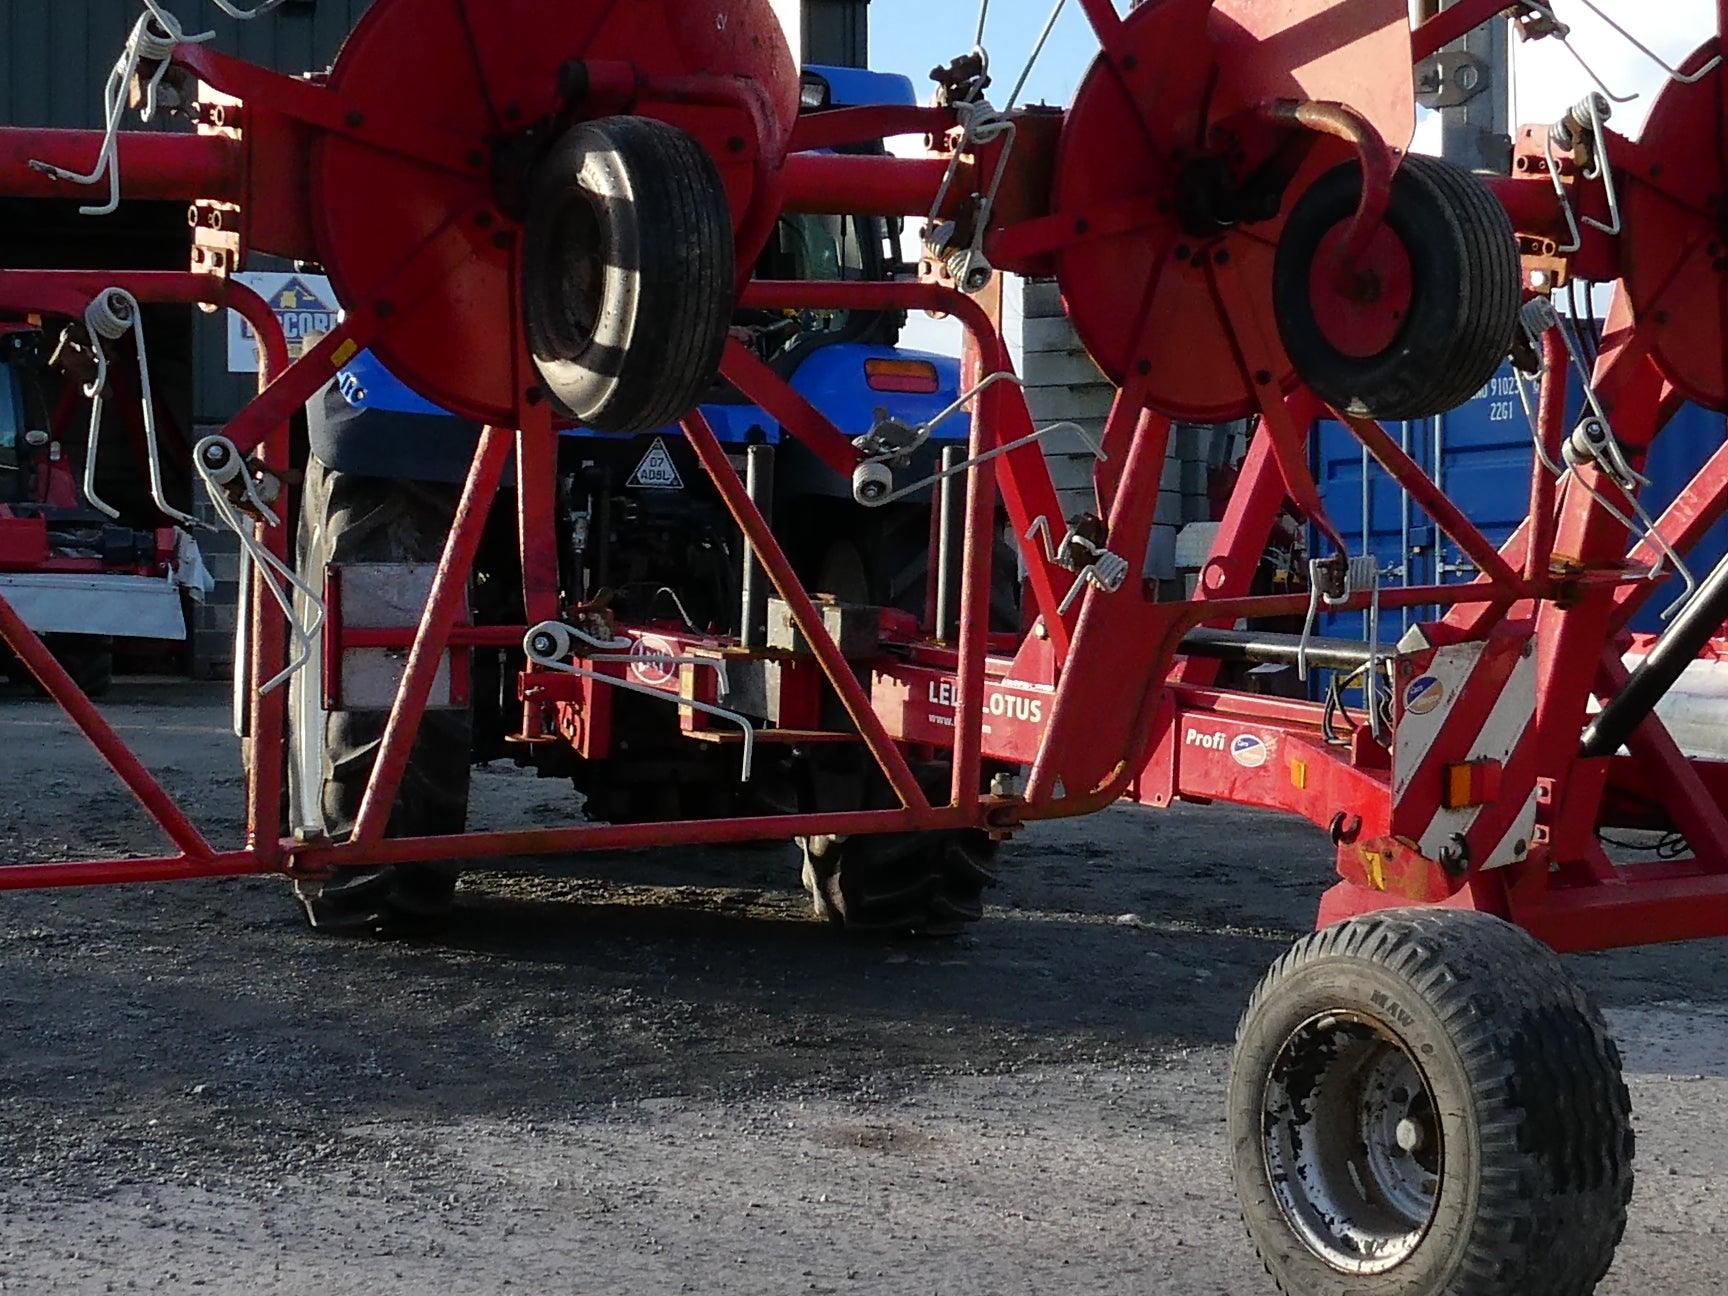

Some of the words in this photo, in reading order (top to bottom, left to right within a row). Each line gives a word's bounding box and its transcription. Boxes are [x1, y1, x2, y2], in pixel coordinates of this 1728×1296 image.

[1490, 401, 1513, 421] 22G1
[929, 680, 960, 708] LEL
[1185, 728, 1227, 751] Profi
